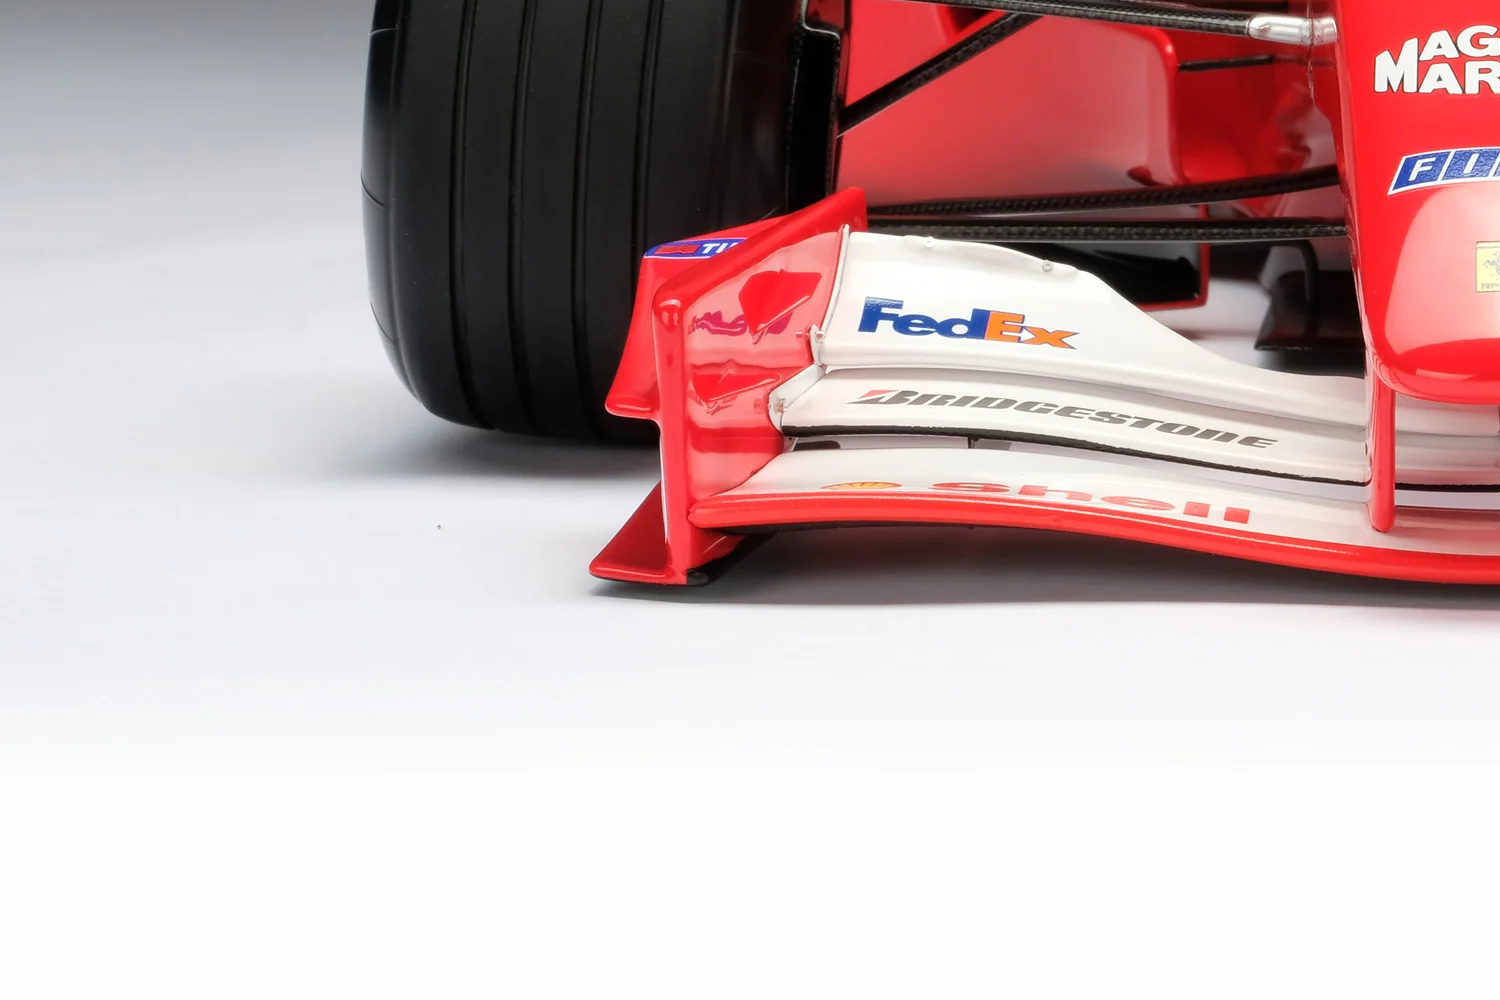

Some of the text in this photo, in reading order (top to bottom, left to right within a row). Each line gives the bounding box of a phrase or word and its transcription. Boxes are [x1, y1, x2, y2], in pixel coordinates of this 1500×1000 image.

[857, 296, 1080, 350] FedEx
[847, 389, 1279, 449] BRIDGESTONE
[929, 482, 1251, 524] Shell
